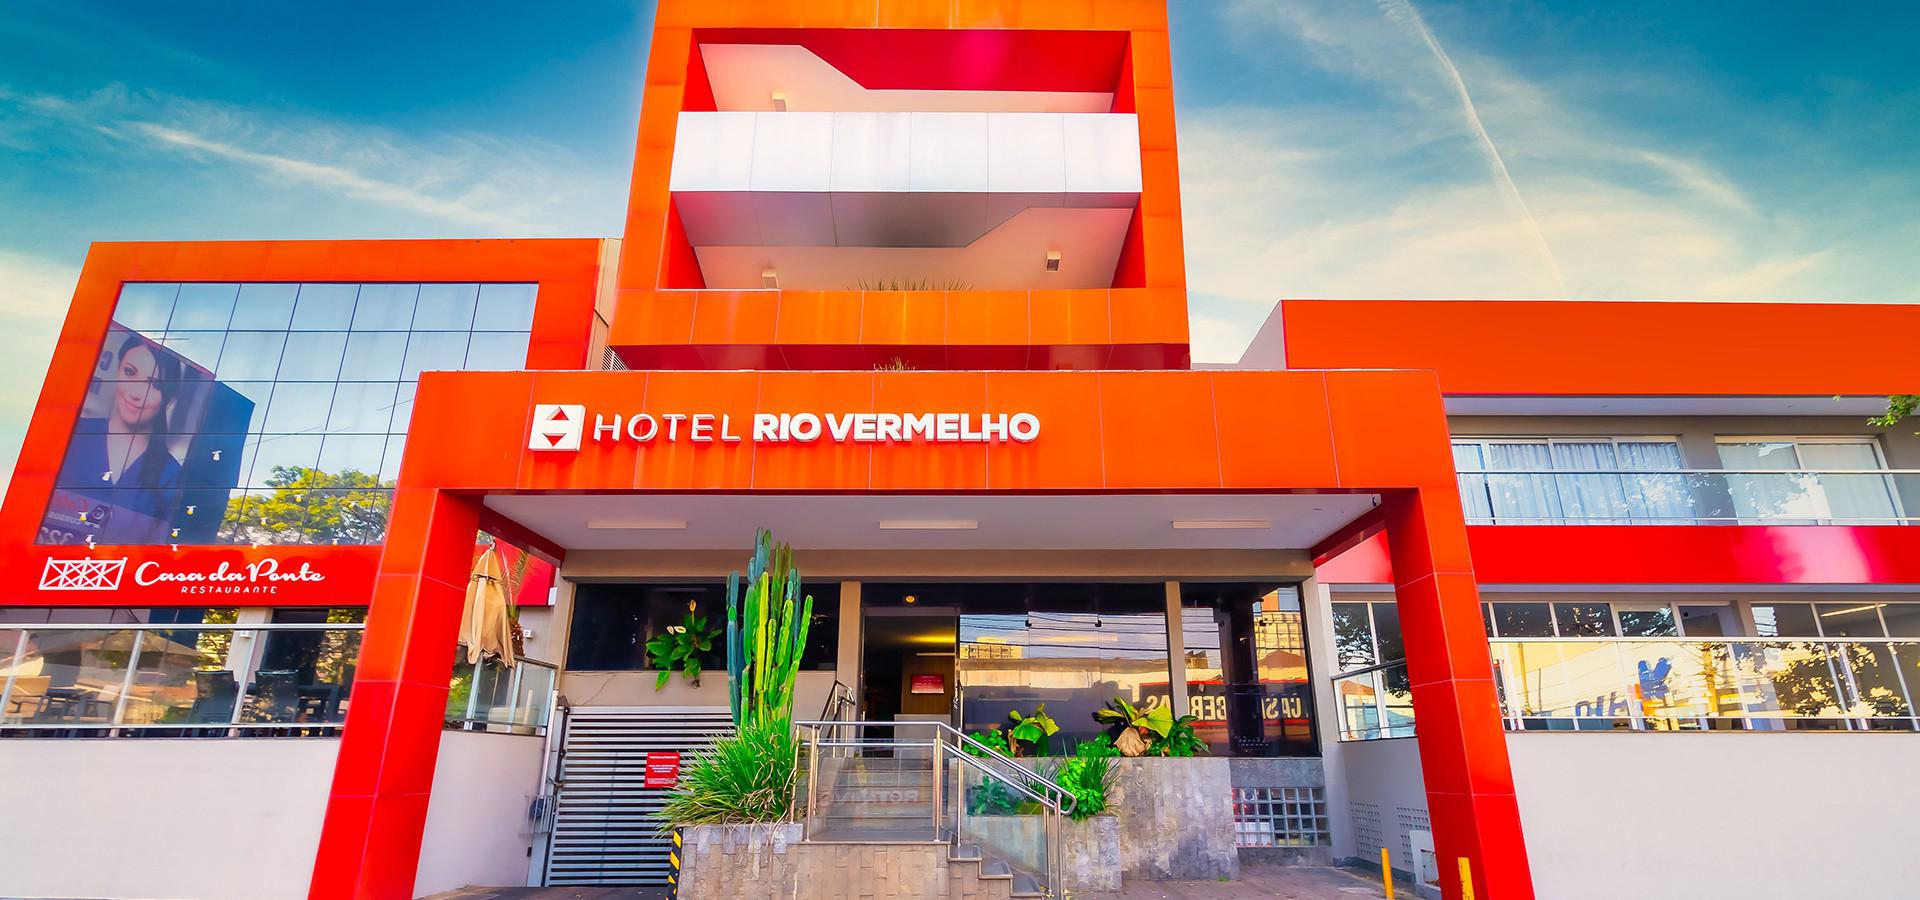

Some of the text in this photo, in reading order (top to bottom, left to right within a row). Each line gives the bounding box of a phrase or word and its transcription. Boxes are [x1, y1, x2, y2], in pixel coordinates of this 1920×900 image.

[592, 413, 1041, 444] HOTEL RIO VERMELHO
[134, 557, 326, 586] Casa da Ponte
[181, 585, 278, 595] RESTAURANTE
